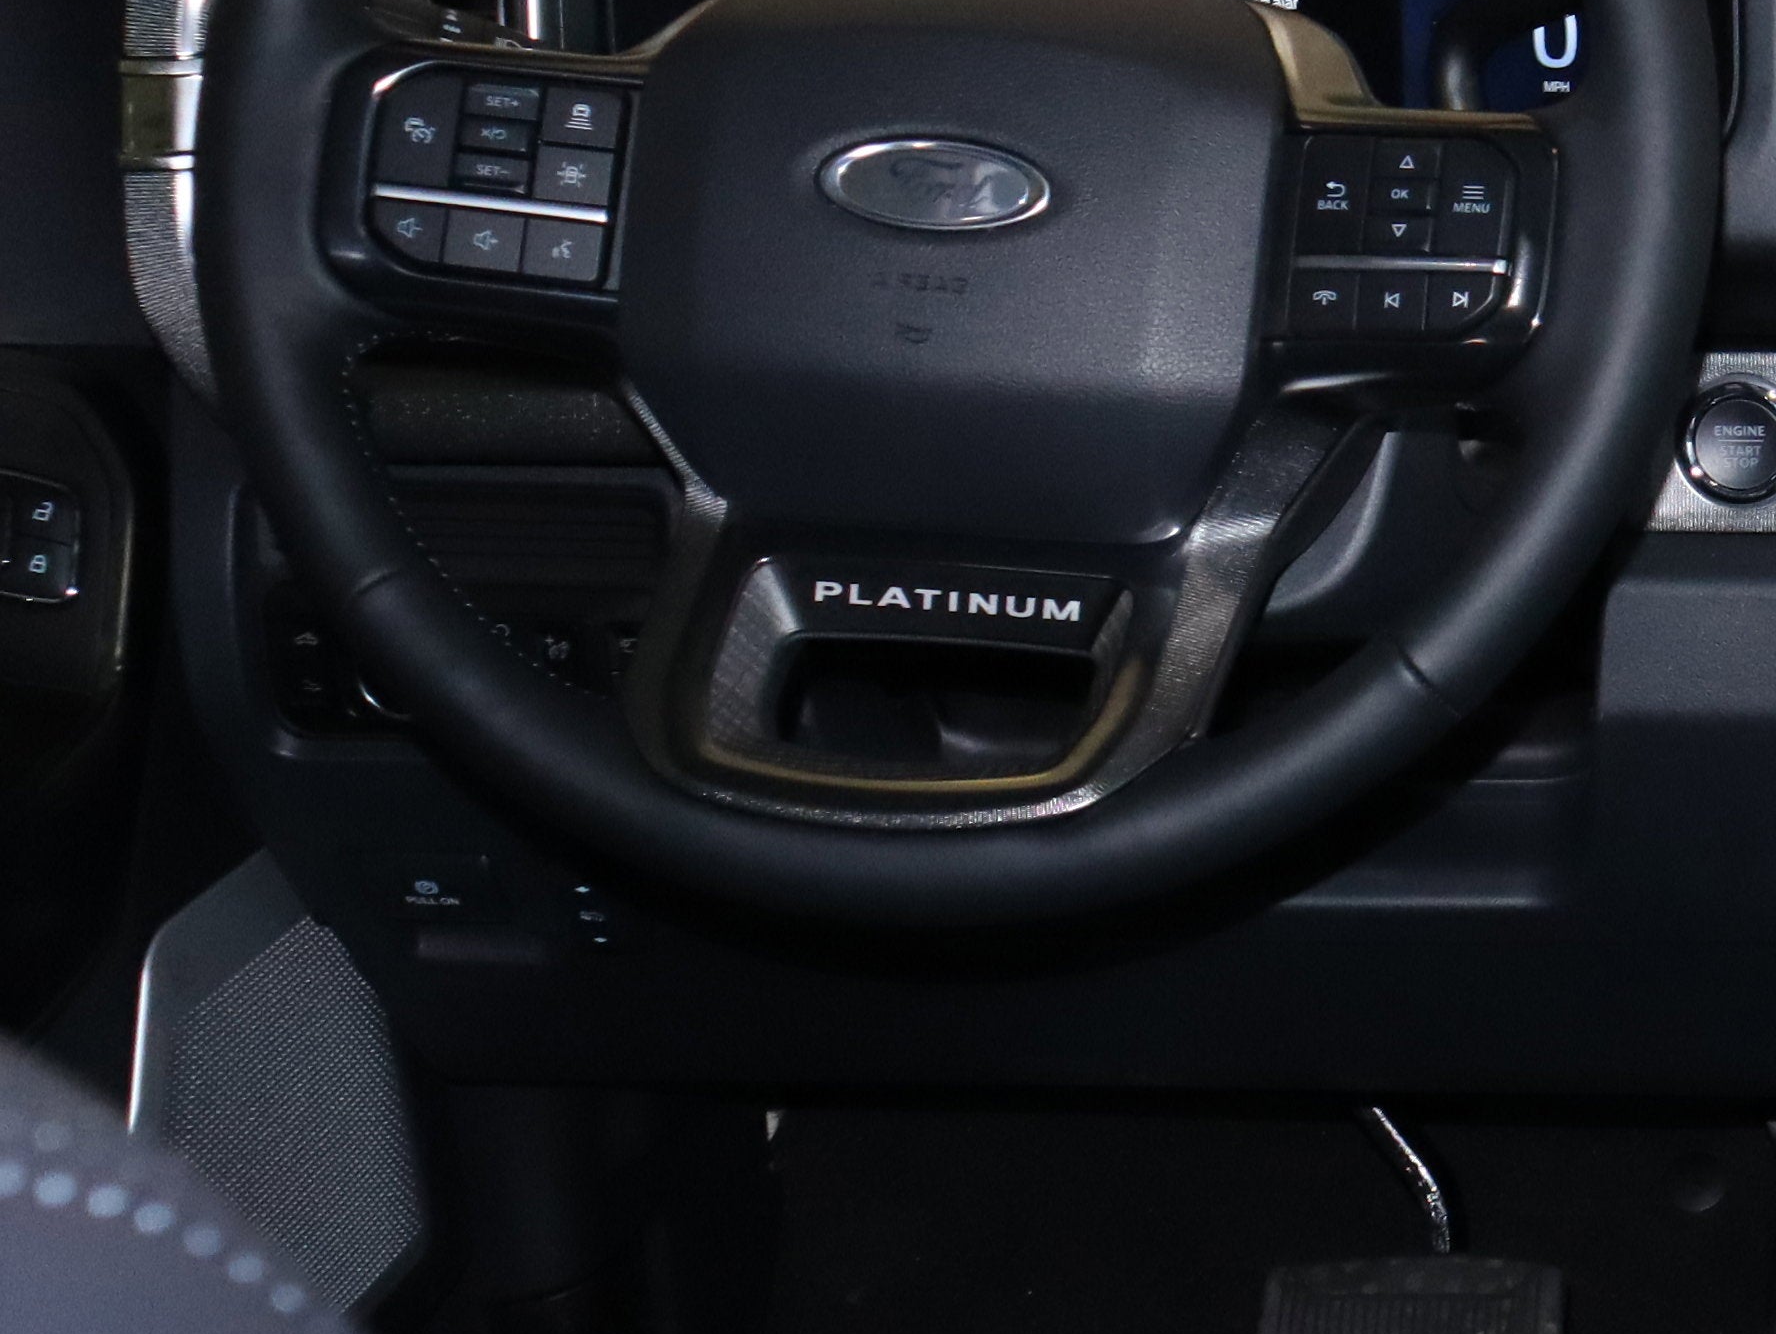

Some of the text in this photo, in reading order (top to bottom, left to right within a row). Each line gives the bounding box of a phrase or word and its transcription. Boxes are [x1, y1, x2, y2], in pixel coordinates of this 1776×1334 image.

[1543, 80, 1570, 93] MPH
[1390, 188, 1409, 200] OK
[1316, 199, 1349, 212] BACK
[1453, 202, 1491, 215] MENU
[1713, 425, 1767, 437] ENGINE
[1720, 445, 1762, 457] START
[1723, 457, 1759, 468] STOP
[813, 580, 1082, 623] PLATINUM
